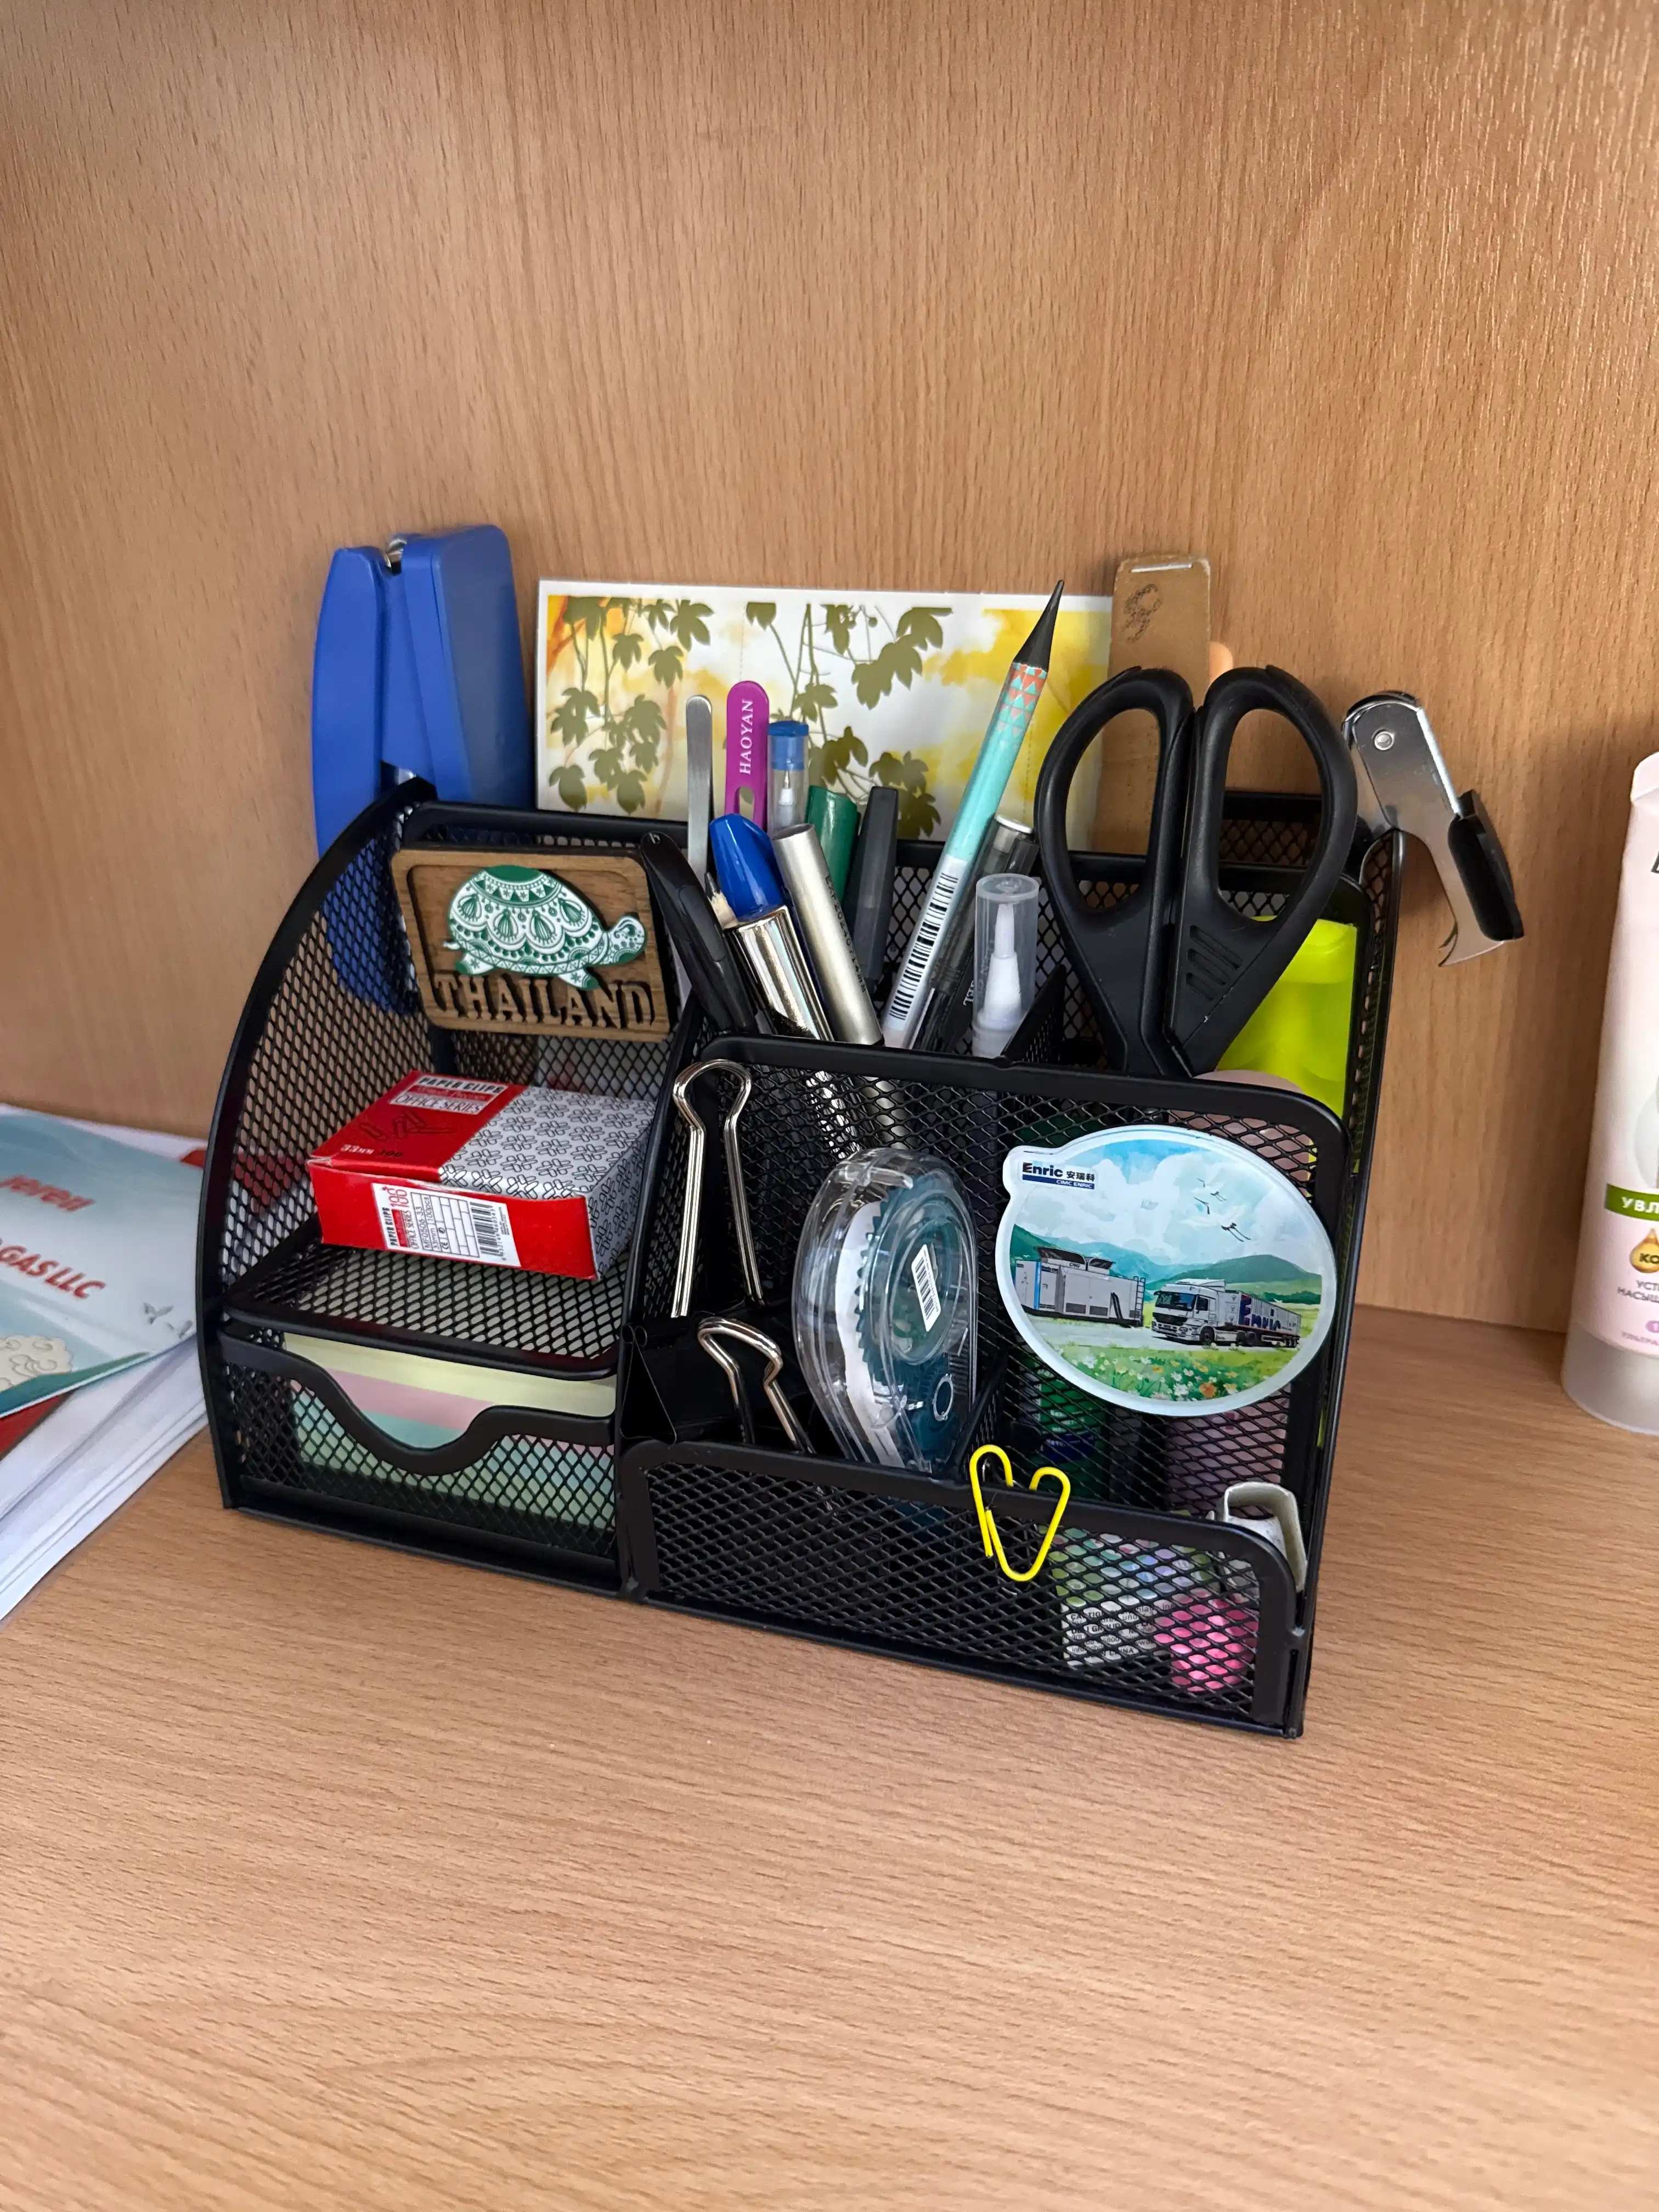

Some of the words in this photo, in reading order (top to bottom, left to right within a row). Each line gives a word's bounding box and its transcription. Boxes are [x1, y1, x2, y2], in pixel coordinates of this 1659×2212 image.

[739, 699, 753, 775] HAOYAN
[436, 974, 655, 1029] THAILAND
[395, 1094, 439, 1108] OFFICE
[439, 1100, 483, 1114] SERIES
[1022, 1162, 1063, 1177] Enric
[1066, 1171, 1095, 1182] 安瑞科
[403, 1210, 415, 1228] SERIES
[424, 1197, 433, 1222] 100pcs
[407, 1229, 419, 1249] OFFICE
[43, 1267, 107, 1300] LLC
